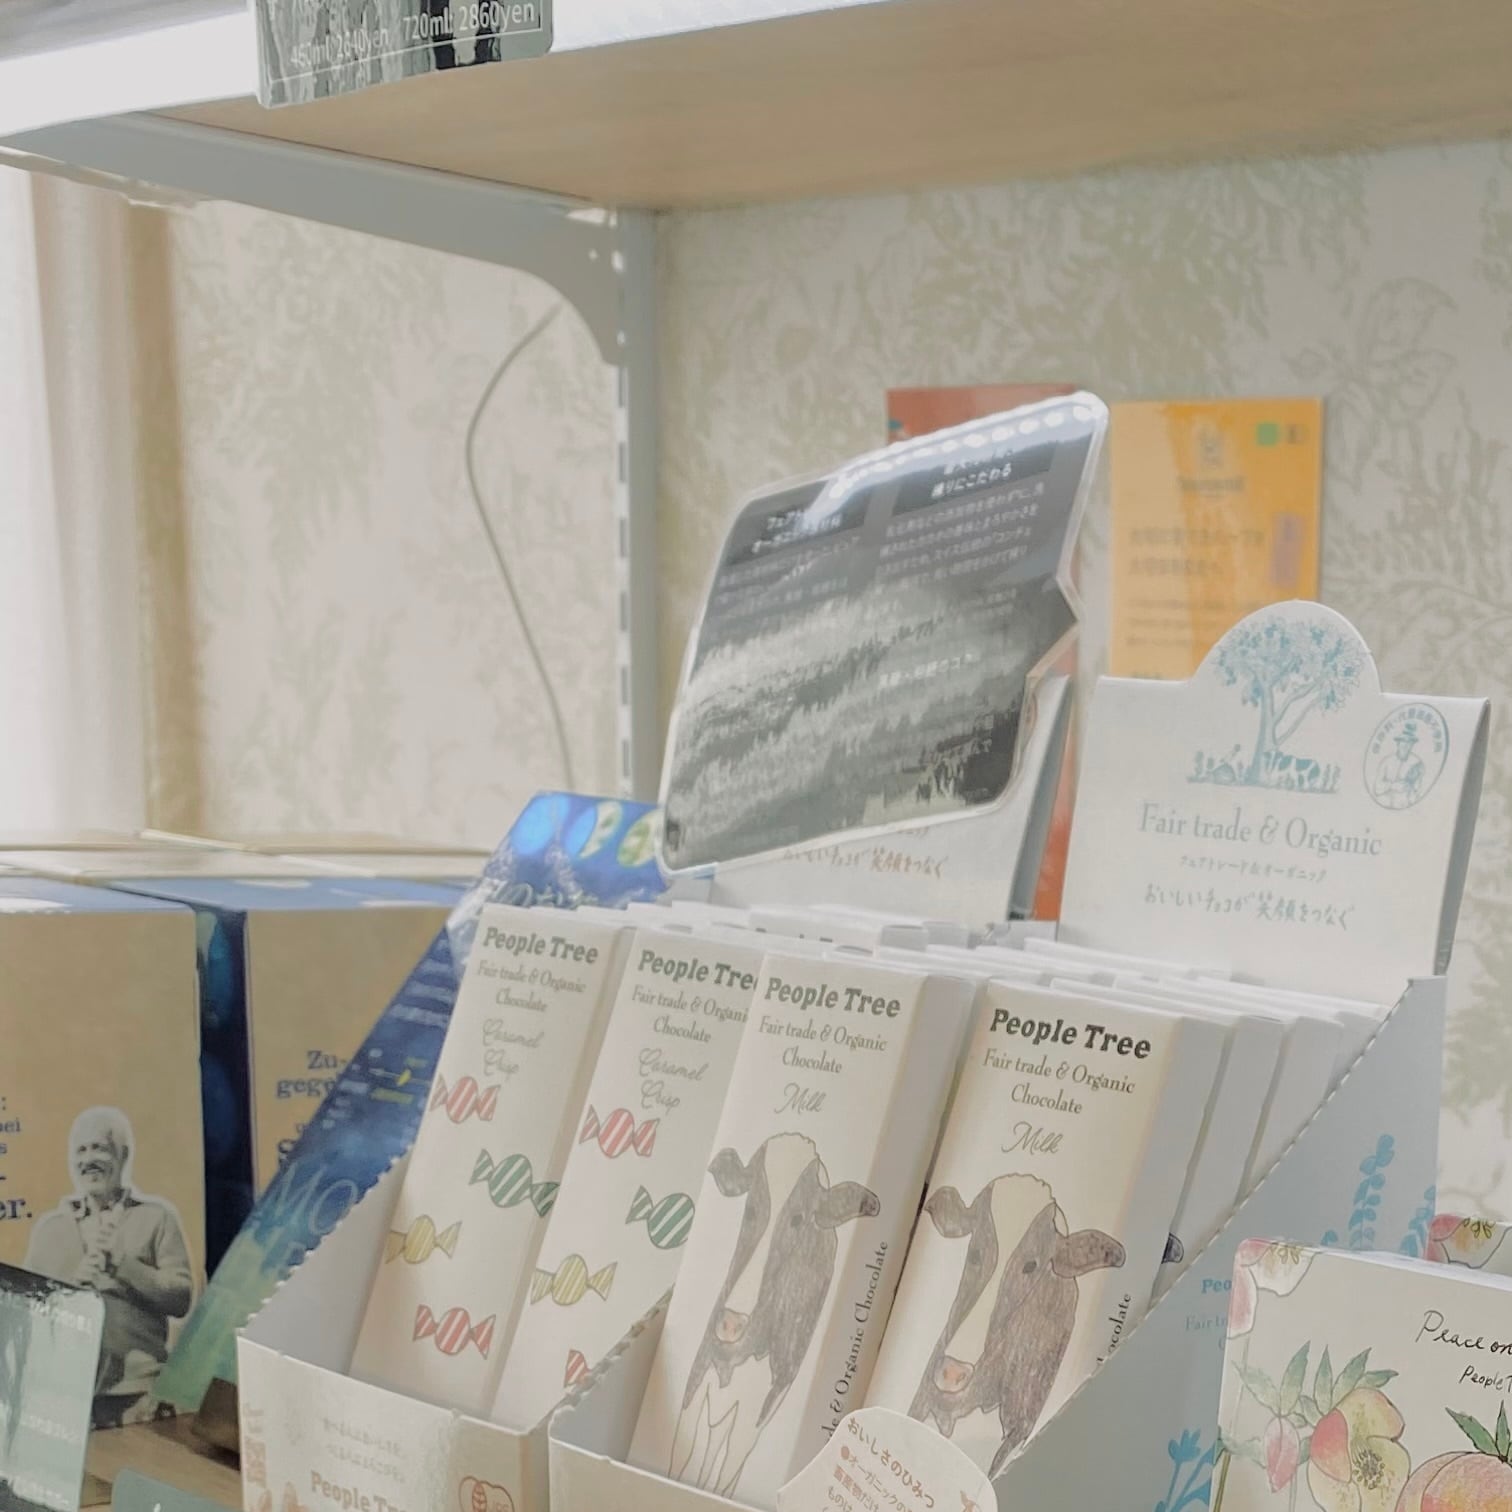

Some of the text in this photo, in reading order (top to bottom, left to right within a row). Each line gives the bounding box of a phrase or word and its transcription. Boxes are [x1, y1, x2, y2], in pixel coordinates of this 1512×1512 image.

[459, 1, 535, 32] 2860yen
[1138, 801, 1383, 858] Fair trade & Organic
[482, 926, 599, 965] People Tree
[477, 961, 500, 979] Fair
[539, 971, 587, 994] Organic
[638, 948, 757, 992] People Tre
[495, 987, 548, 1013] Chocolate
[631, 983, 749, 1024] Fair trade & Organi
[764, 976, 902, 1019] People Tree
[653, 1015, 712, 1045] Chocolate
[758, 1015, 888, 1054] Fair trade & Organic
[989, 1008, 1152, 1060] People Tree
[637, 1047, 710, 1083] Caramel
[782, 1047, 843, 1076] Chocolate
[982, 1047, 1136, 1095] Fair trade & Organic
[774, 1081, 828, 1116] Milk
[1011, 1082, 1083, 1116] Chocolate
[1001, 1120, 1065, 1155] Milk
[1202, 1278, 1231, 1294] Peo
[833, 1325, 867, 1395] Organic
[854, 1240, 890, 1325] Chocolate
[1097, 1292, 1132, 1362] ocolate
[1415, 1308, 1486, 1352] Peace
[1459, 1364, 1504, 1391] People
[847, 1416, 936, 1509] おいしさのひみつ
